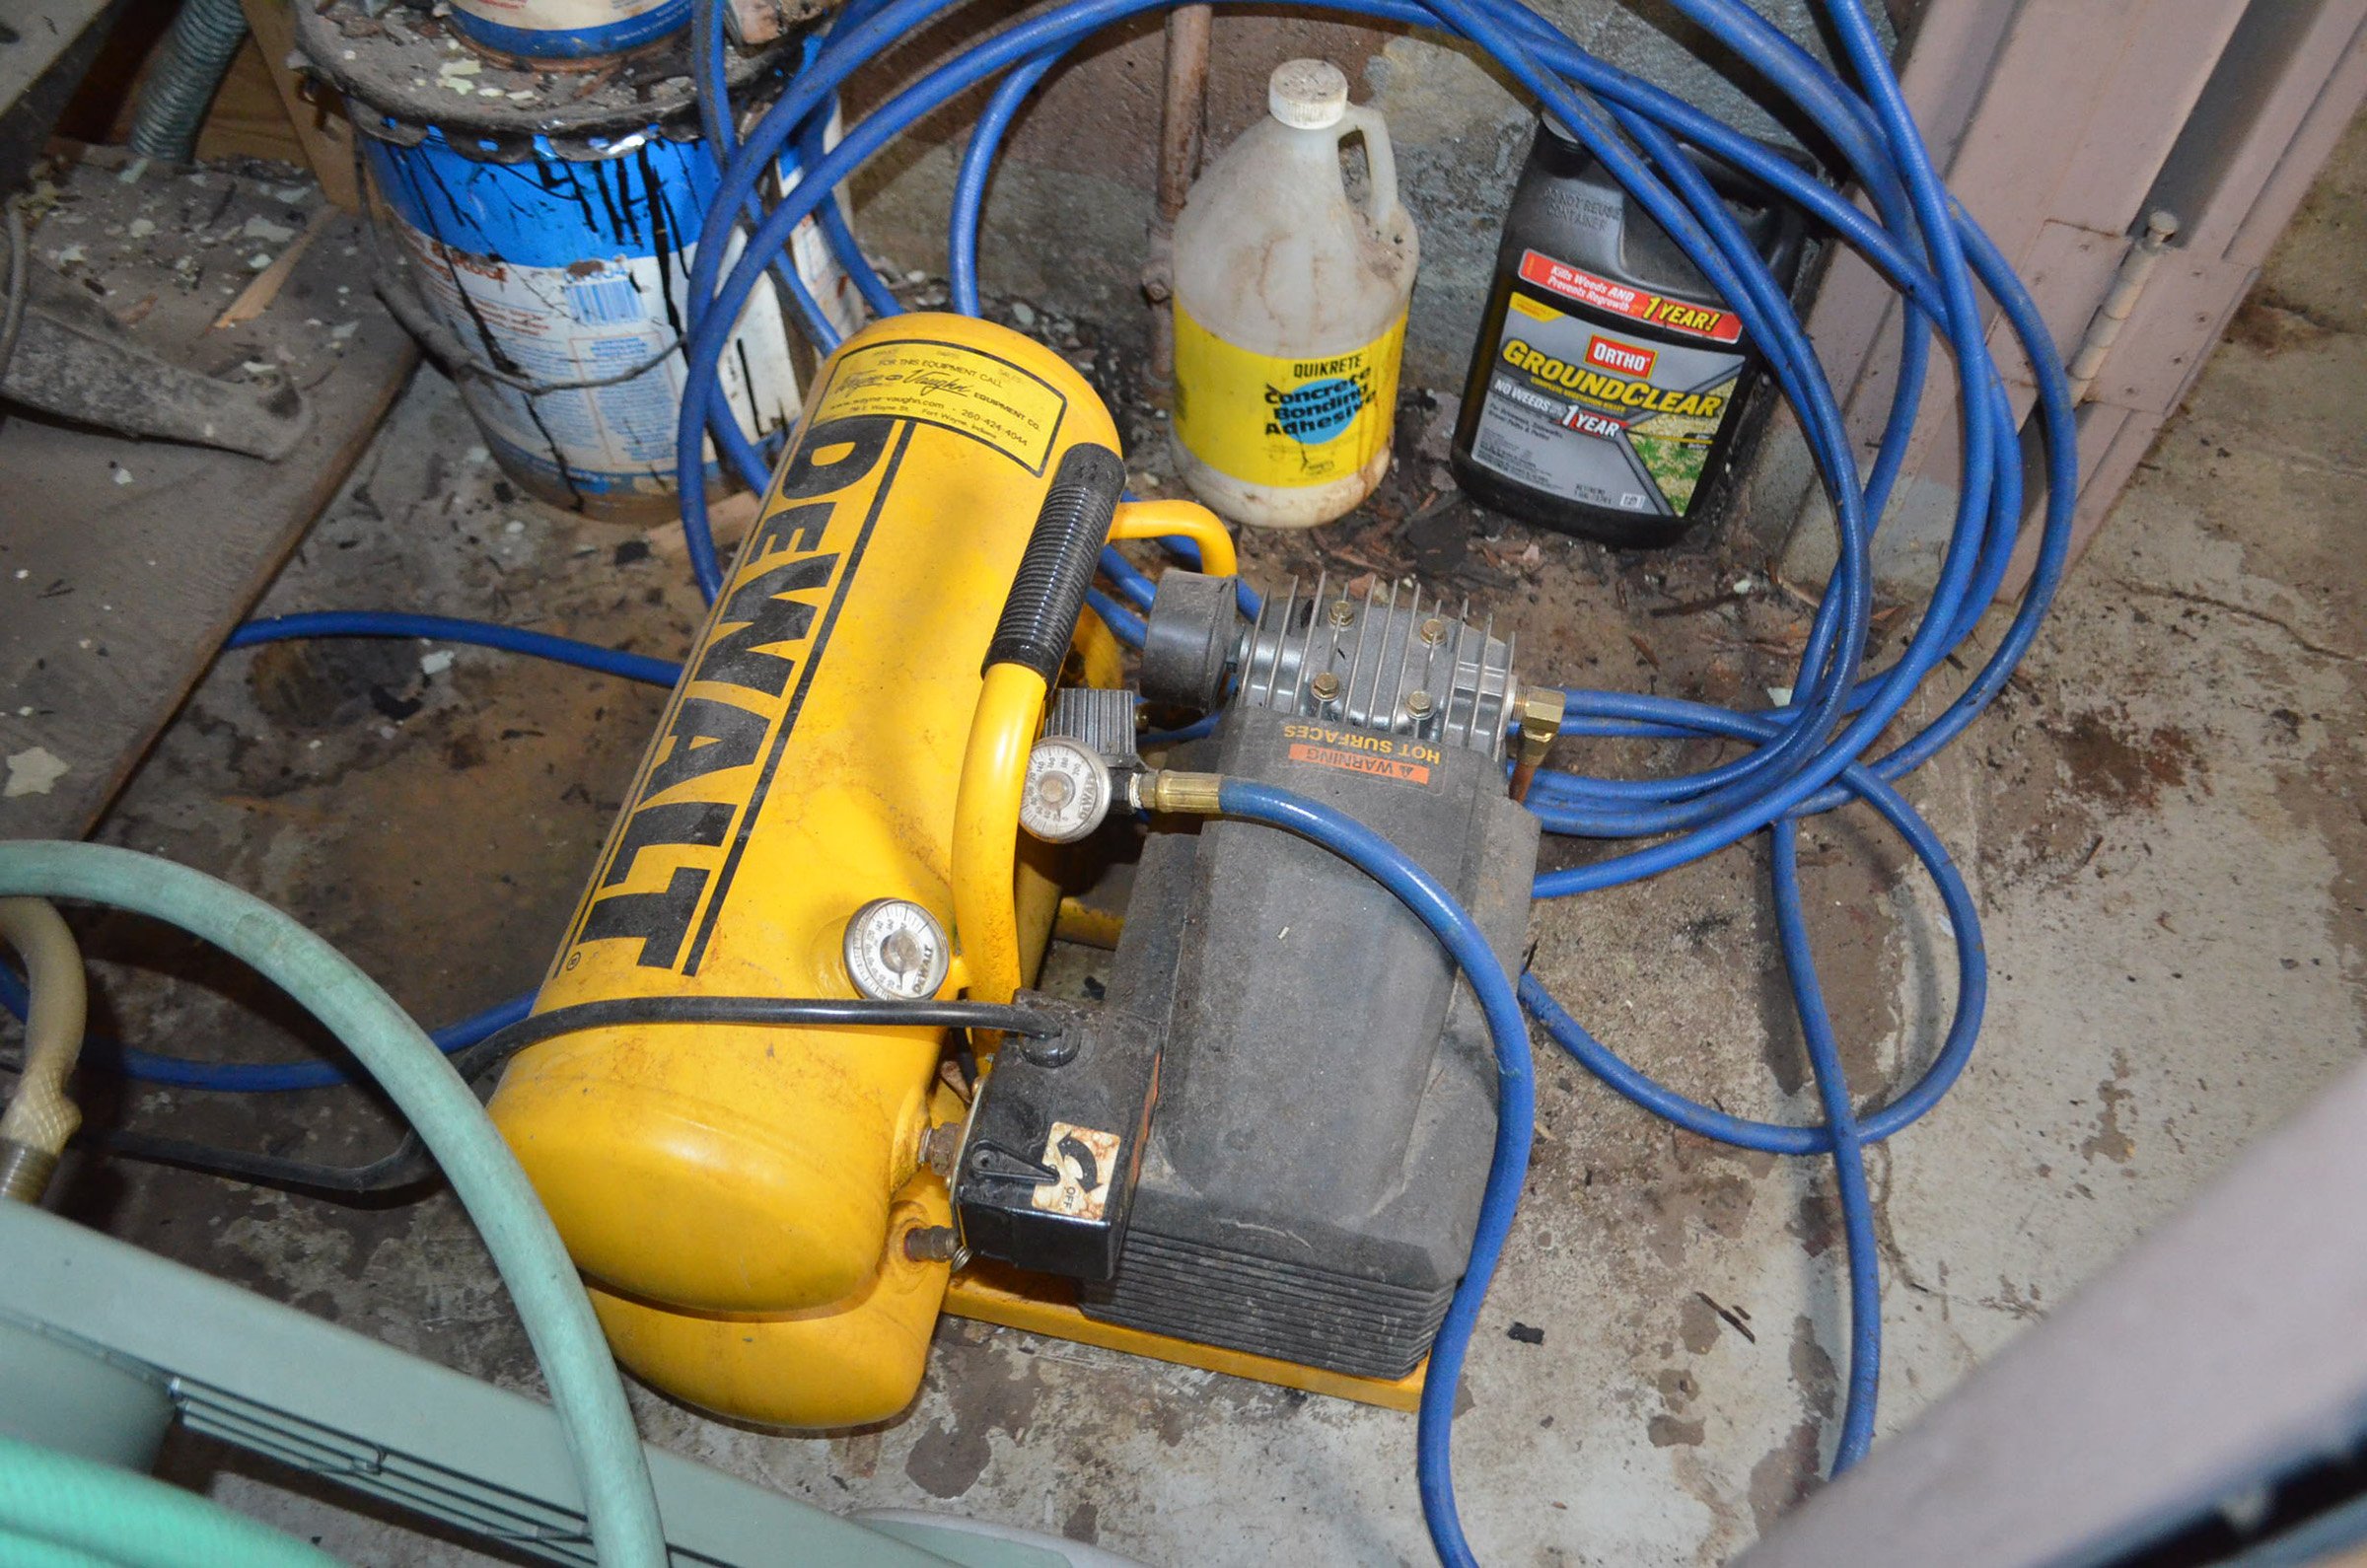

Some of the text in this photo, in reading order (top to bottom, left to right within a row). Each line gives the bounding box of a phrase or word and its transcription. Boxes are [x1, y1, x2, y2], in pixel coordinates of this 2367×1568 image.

[1547, 275, 1586, 298] Prevents
[1586, 290, 1629, 313] Regrowth
[1550, 264, 1573, 281] Kills
[1574, 273, 1608, 294] Weeds
[1608, 286, 1635, 304] AND
[1642, 296, 1720, 332] 1 YEAR!
[922, 359, 977, 377] EQUIPMENT
[979, 374, 1003, 389] CALL
[1294, 354, 1362, 378] QUIKRETE
[1594, 342, 1646, 372] ORTHO
[1264, 367, 1372, 404] Concrete
[1274, 384, 1369, 420] Bonding
[973, 392, 1026, 421] EQUIPMENT
[1265, 391, 1376, 435] Adhesive
[1494, 379, 1512, 395] NO
[1510, 387, 1551, 412] WEEDS
[1562, 404, 1579, 427] 1
[1575, 413, 1620, 438] YEAR
[577, 416, 895, 969] DEWALT
[1284, 725, 1440, 764] HOT SURFACES
[1306, 748, 1394, 773] WARNING
[1064, 1186, 1076, 1209] OFF
